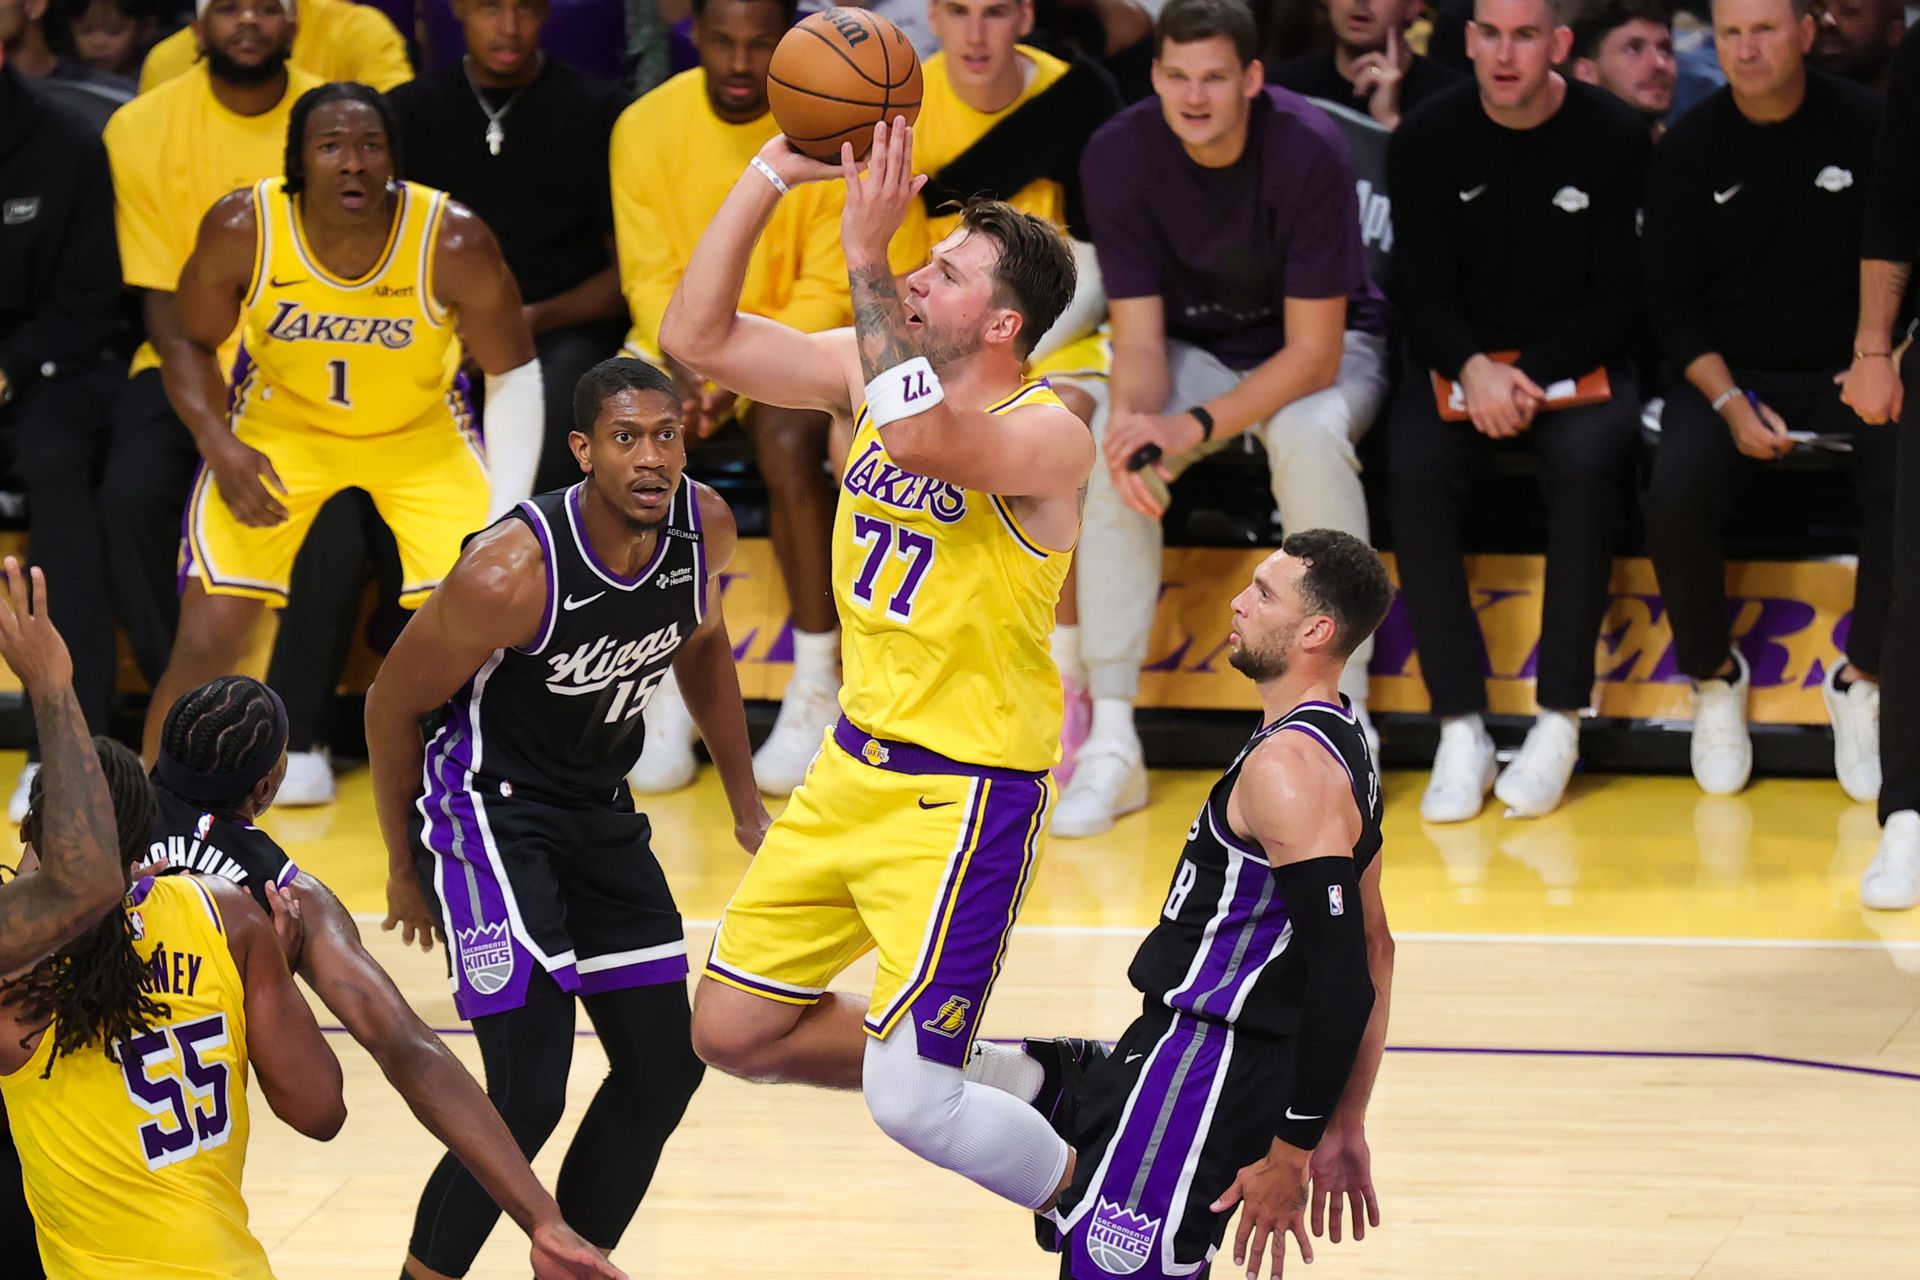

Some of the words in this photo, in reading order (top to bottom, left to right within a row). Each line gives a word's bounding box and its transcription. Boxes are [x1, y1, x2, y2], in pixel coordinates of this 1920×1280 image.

[265, 300, 414, 349] LAKERS
[327, 359, 352, 409] 1
[844, 440, 968, 524] LAKERS
[667, 528, 699, 541] ADELMAN
[670, 567, 692, 578] Sutter
[670, 574, 693, 587] Health
[852, 511, 936, 625] 77
[545, 621, 682, 696] Kings
[464, 949, 511, 971] KINGS
[114, 1011, 232, 1172] 55
[1090, 1224, 1149, 1258] KINGS
[1096, 1217, 1150, 1242] SACRAMENTO
